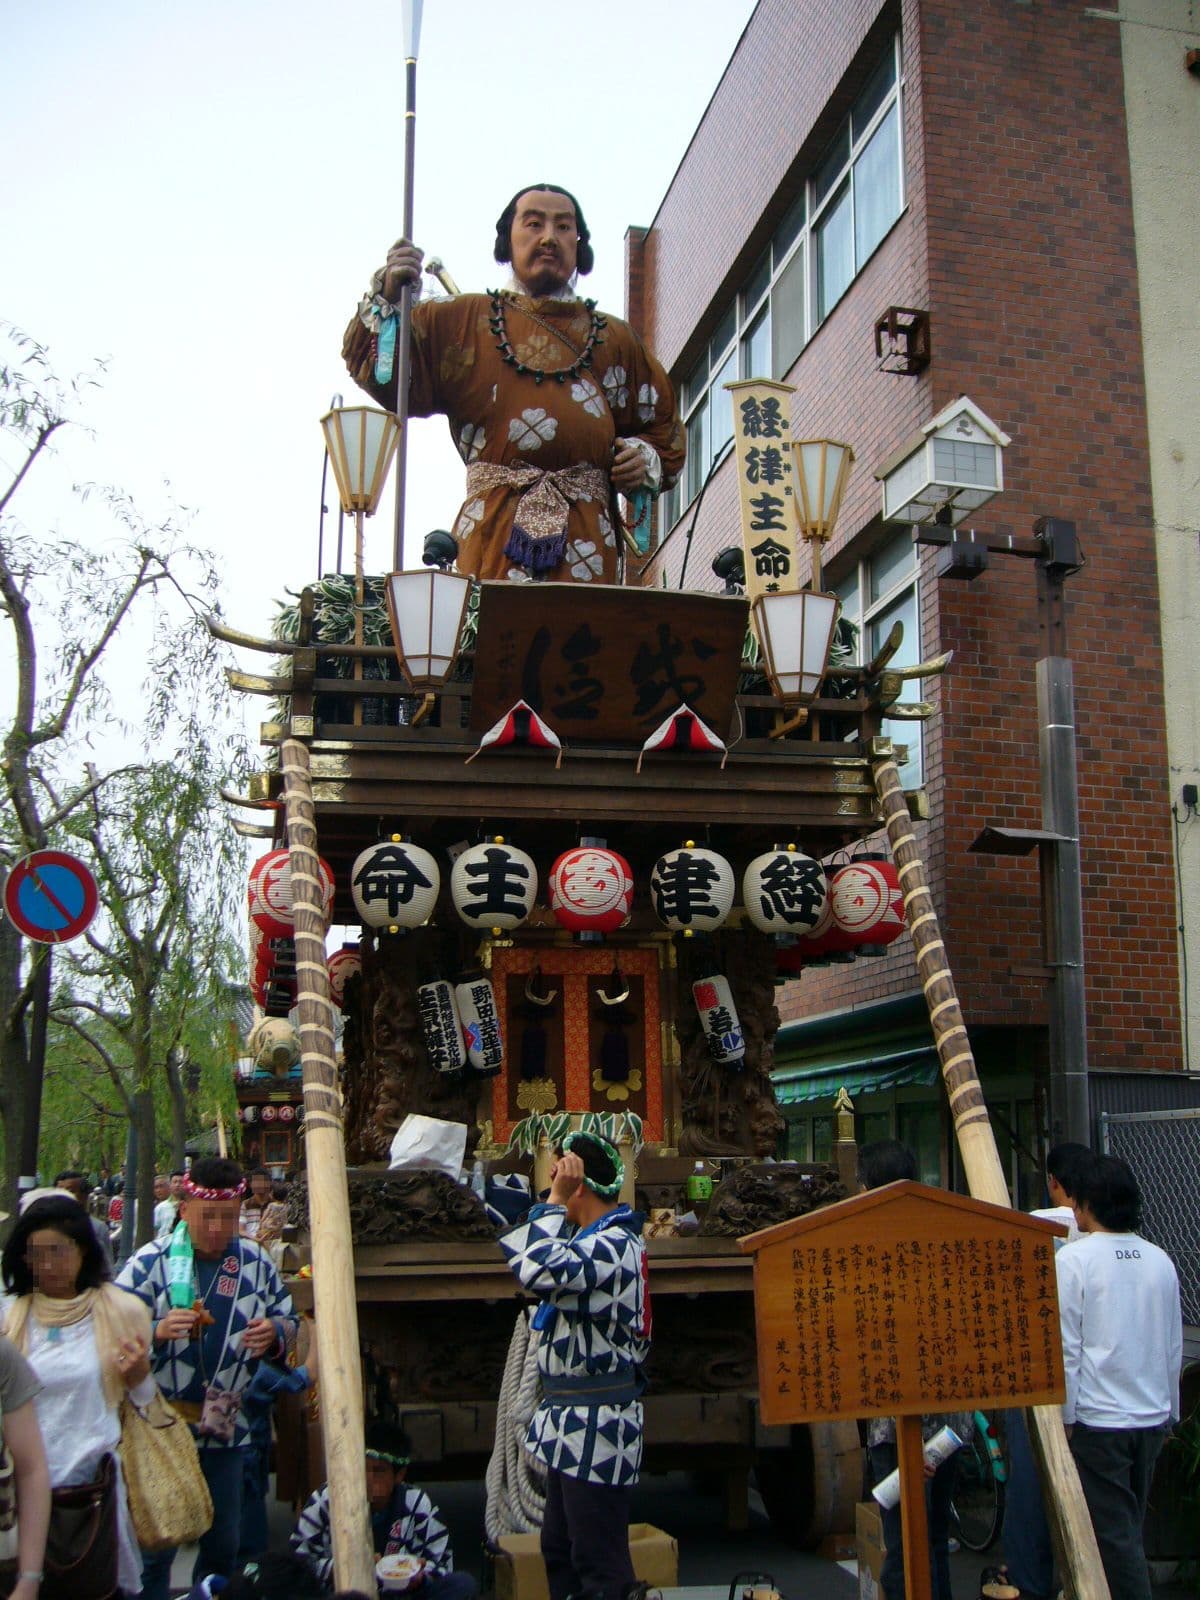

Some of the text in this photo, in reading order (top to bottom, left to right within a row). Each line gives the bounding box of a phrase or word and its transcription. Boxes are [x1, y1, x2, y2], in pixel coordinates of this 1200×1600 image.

[740, 396, 790, 578] 経津主命
[353, 845, 433, 918] 命
[461, 847, 529, 919] 主
[652, 852, 721, 925] 津
[760, 855, 827, 927] 経
[1115, 1249, 1141, 1260] D&G
